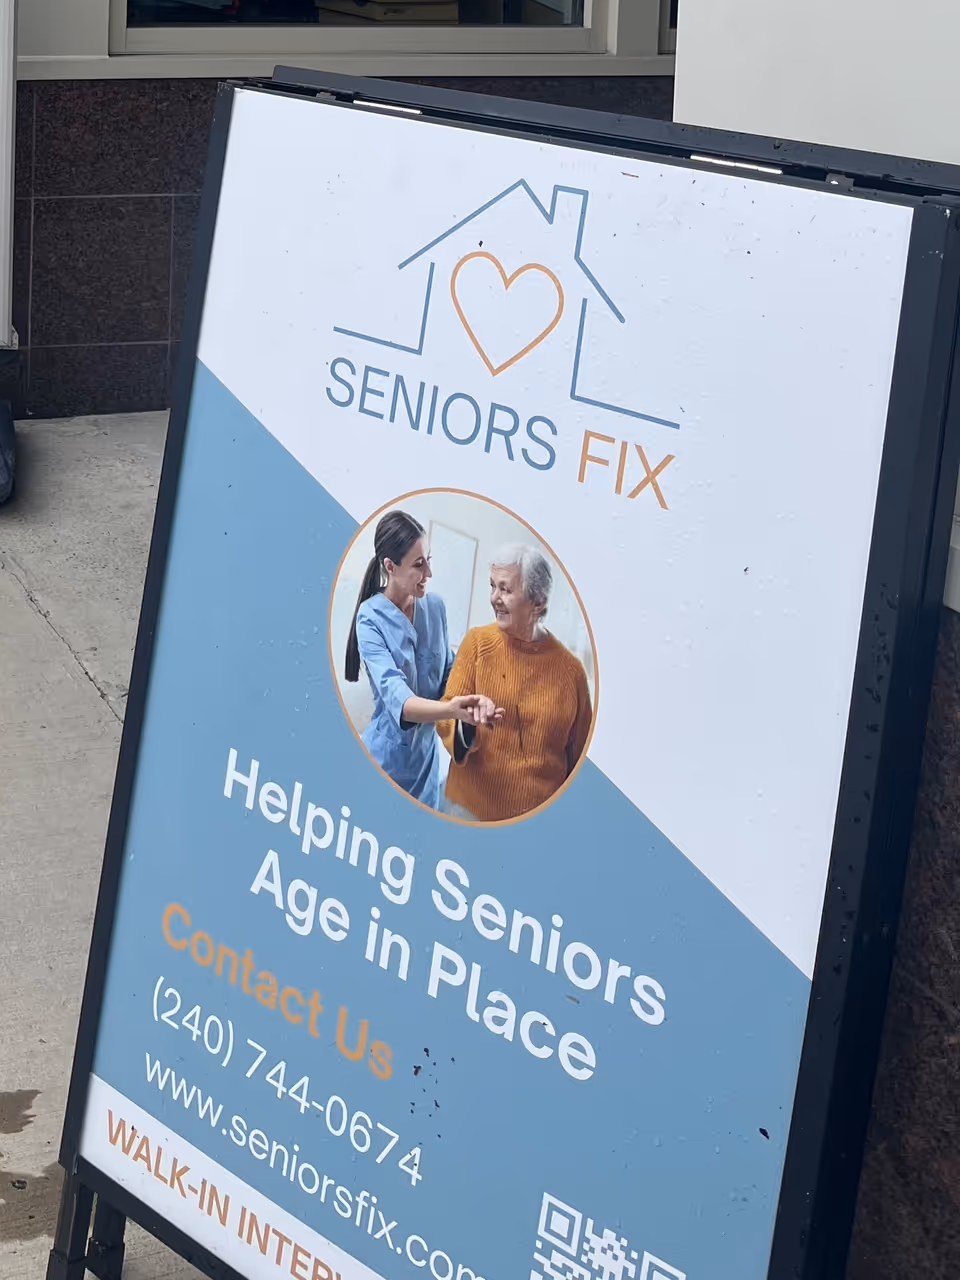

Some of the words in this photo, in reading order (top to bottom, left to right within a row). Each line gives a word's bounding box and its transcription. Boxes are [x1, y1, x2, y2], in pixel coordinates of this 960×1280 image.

[325, 356, 558, 471] SENIORS
[577, 428, 676, 510] FIX
[223, 747, 416, 905] Helping
[431, 858, 667, 1026] Seniors
[249, 849, 350, 942] Age
[364, 906, 411, 982] in
[427, 940, 597, 1081] Place
[152, 975, 234, 1068] (240)
[244, 1037, 423, 1187] 744-0674
[161, 902, 324, 1039] Contact
[335, 1005, 393, 1080] Us
[106, 1108, 232, 1228] WALK-IN
[237, 1205, 342, 1280] INTER
